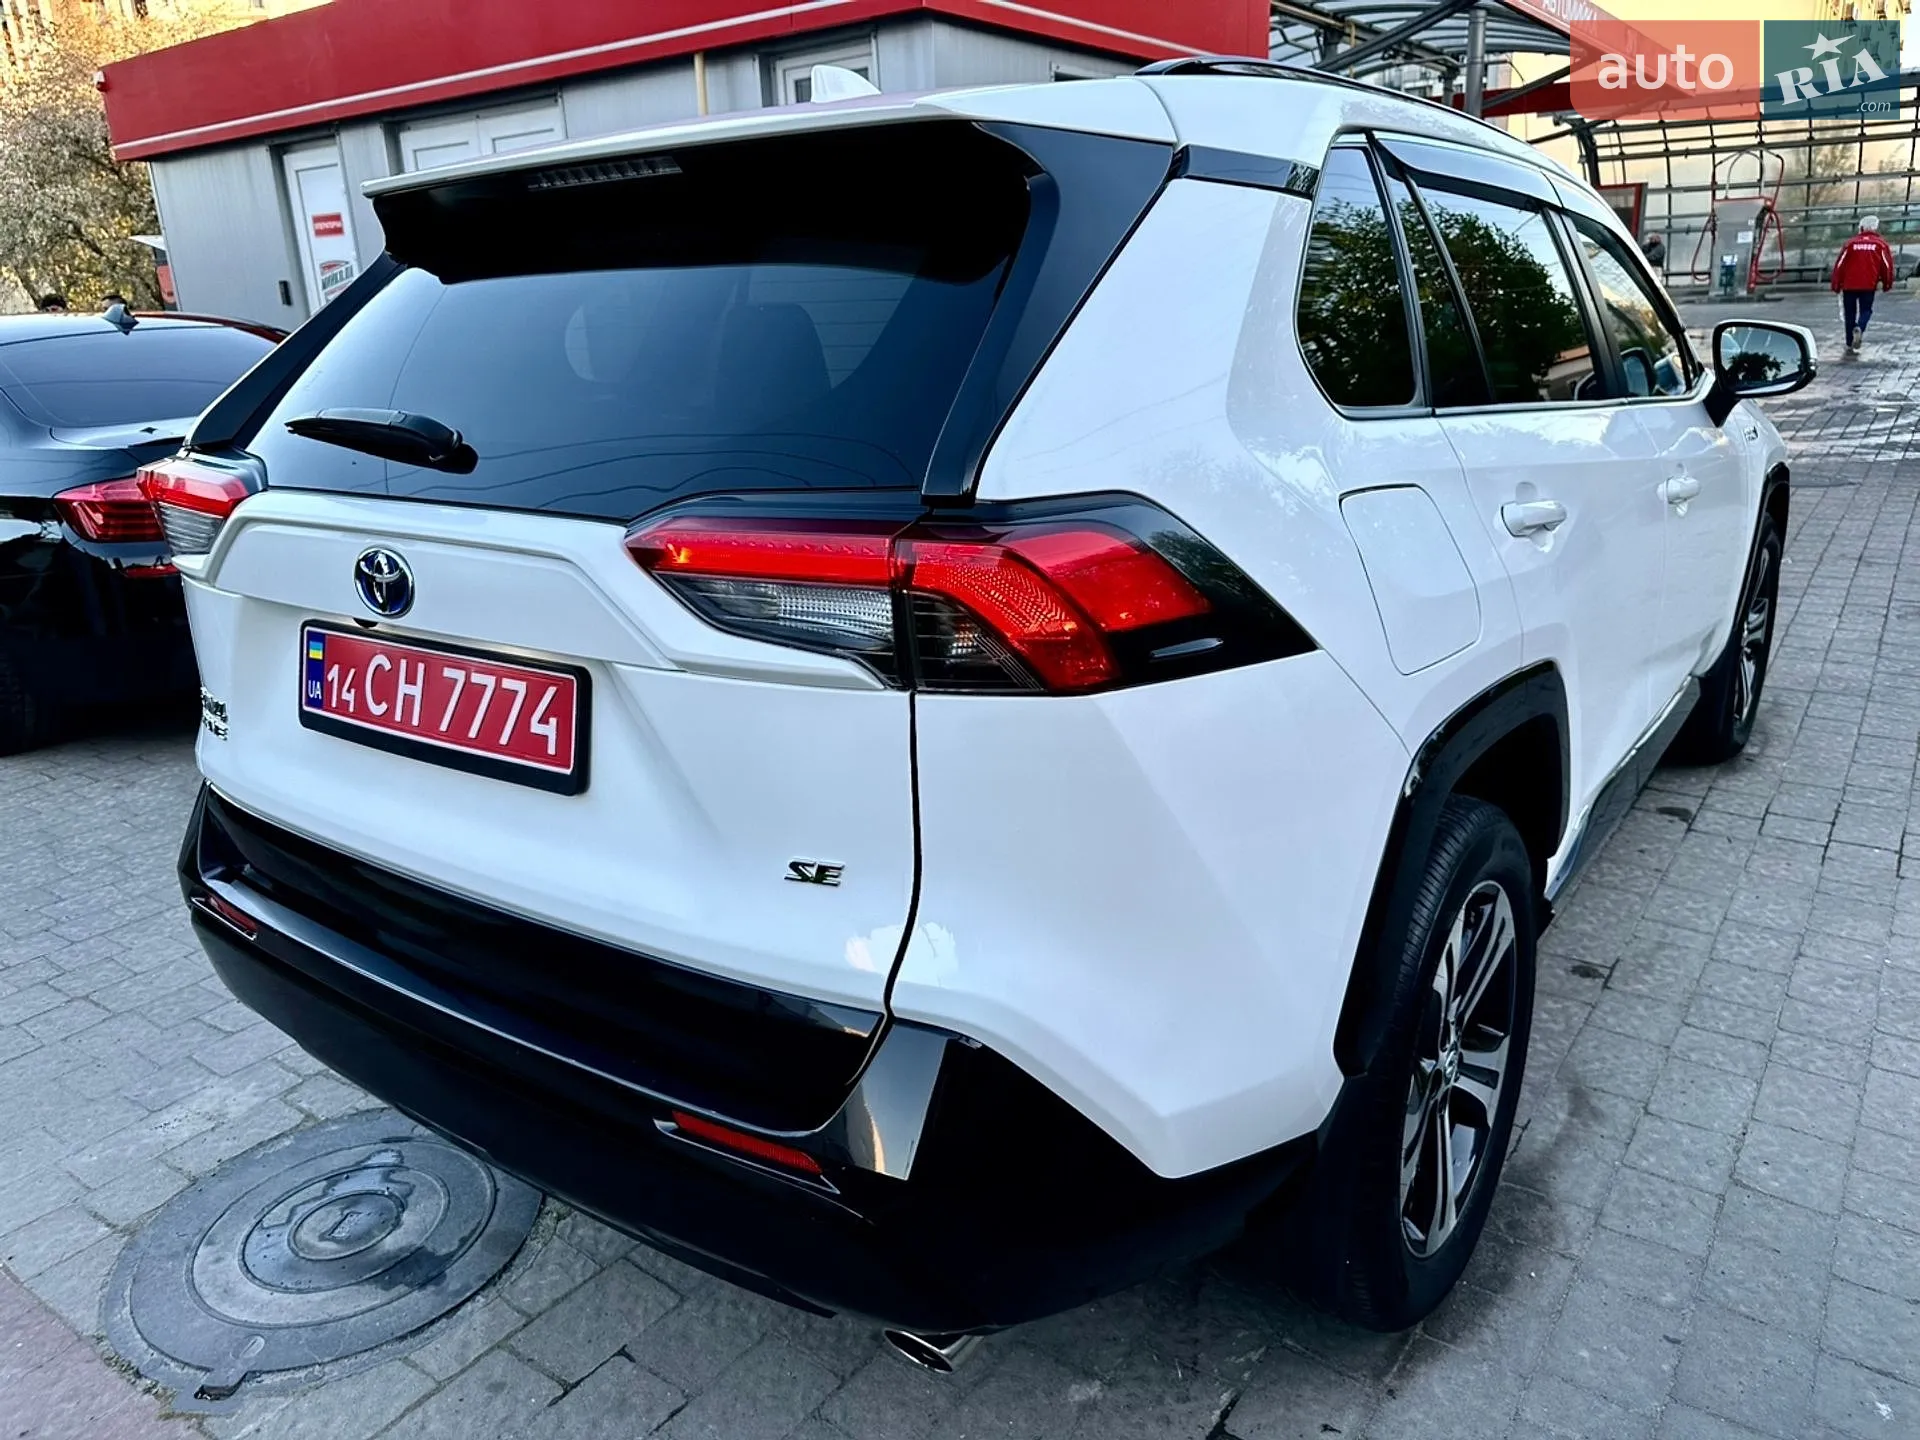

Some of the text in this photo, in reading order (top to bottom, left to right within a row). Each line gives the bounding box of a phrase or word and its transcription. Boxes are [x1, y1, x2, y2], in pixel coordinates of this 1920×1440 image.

[307, 680, 322, 700] UA
[327, 654, 557, 755] 14 CH 7774
[783, 859, 846, 887] SE
